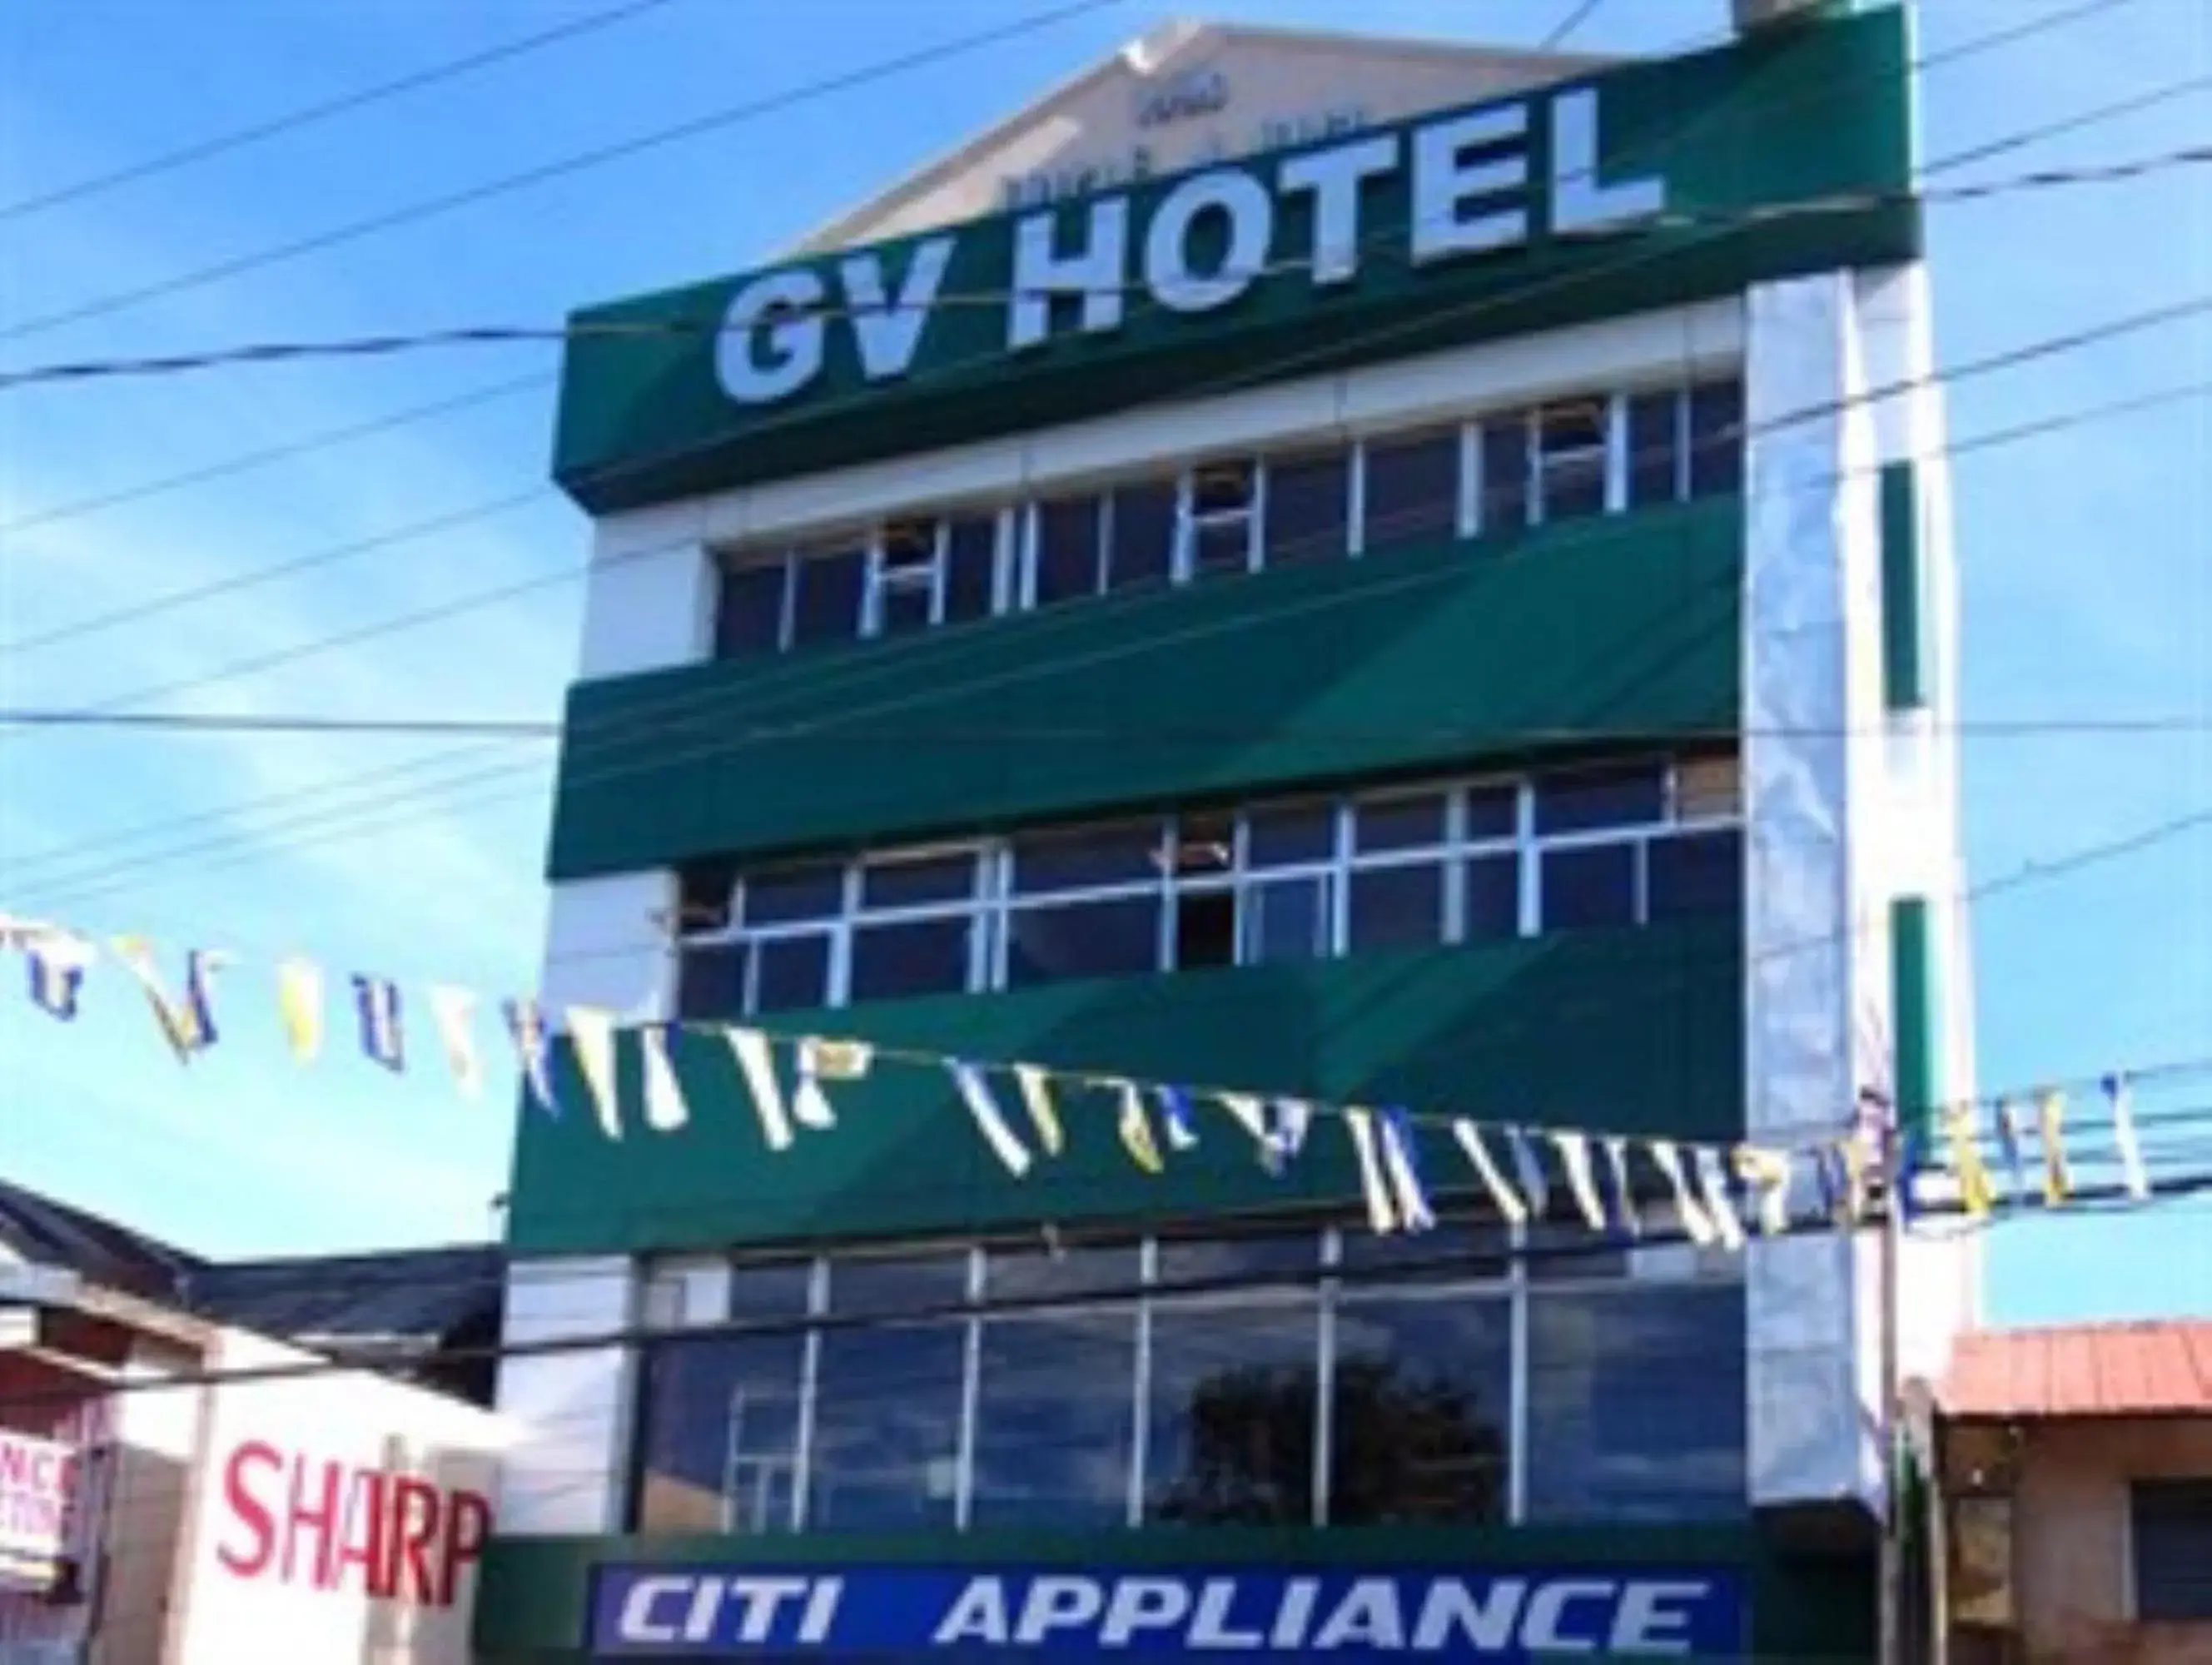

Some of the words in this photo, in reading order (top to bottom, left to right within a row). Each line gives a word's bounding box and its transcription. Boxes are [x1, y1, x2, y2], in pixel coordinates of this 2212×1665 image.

[715, 239, 954, 404] GV
[1009, 87, 1665, 350] HOTEL
[218, 1441, 493, 1607] SHARP
[619, 1576, 844, 1643] CITI
[931, 1576, 1709, 1652] APPLIANCE
